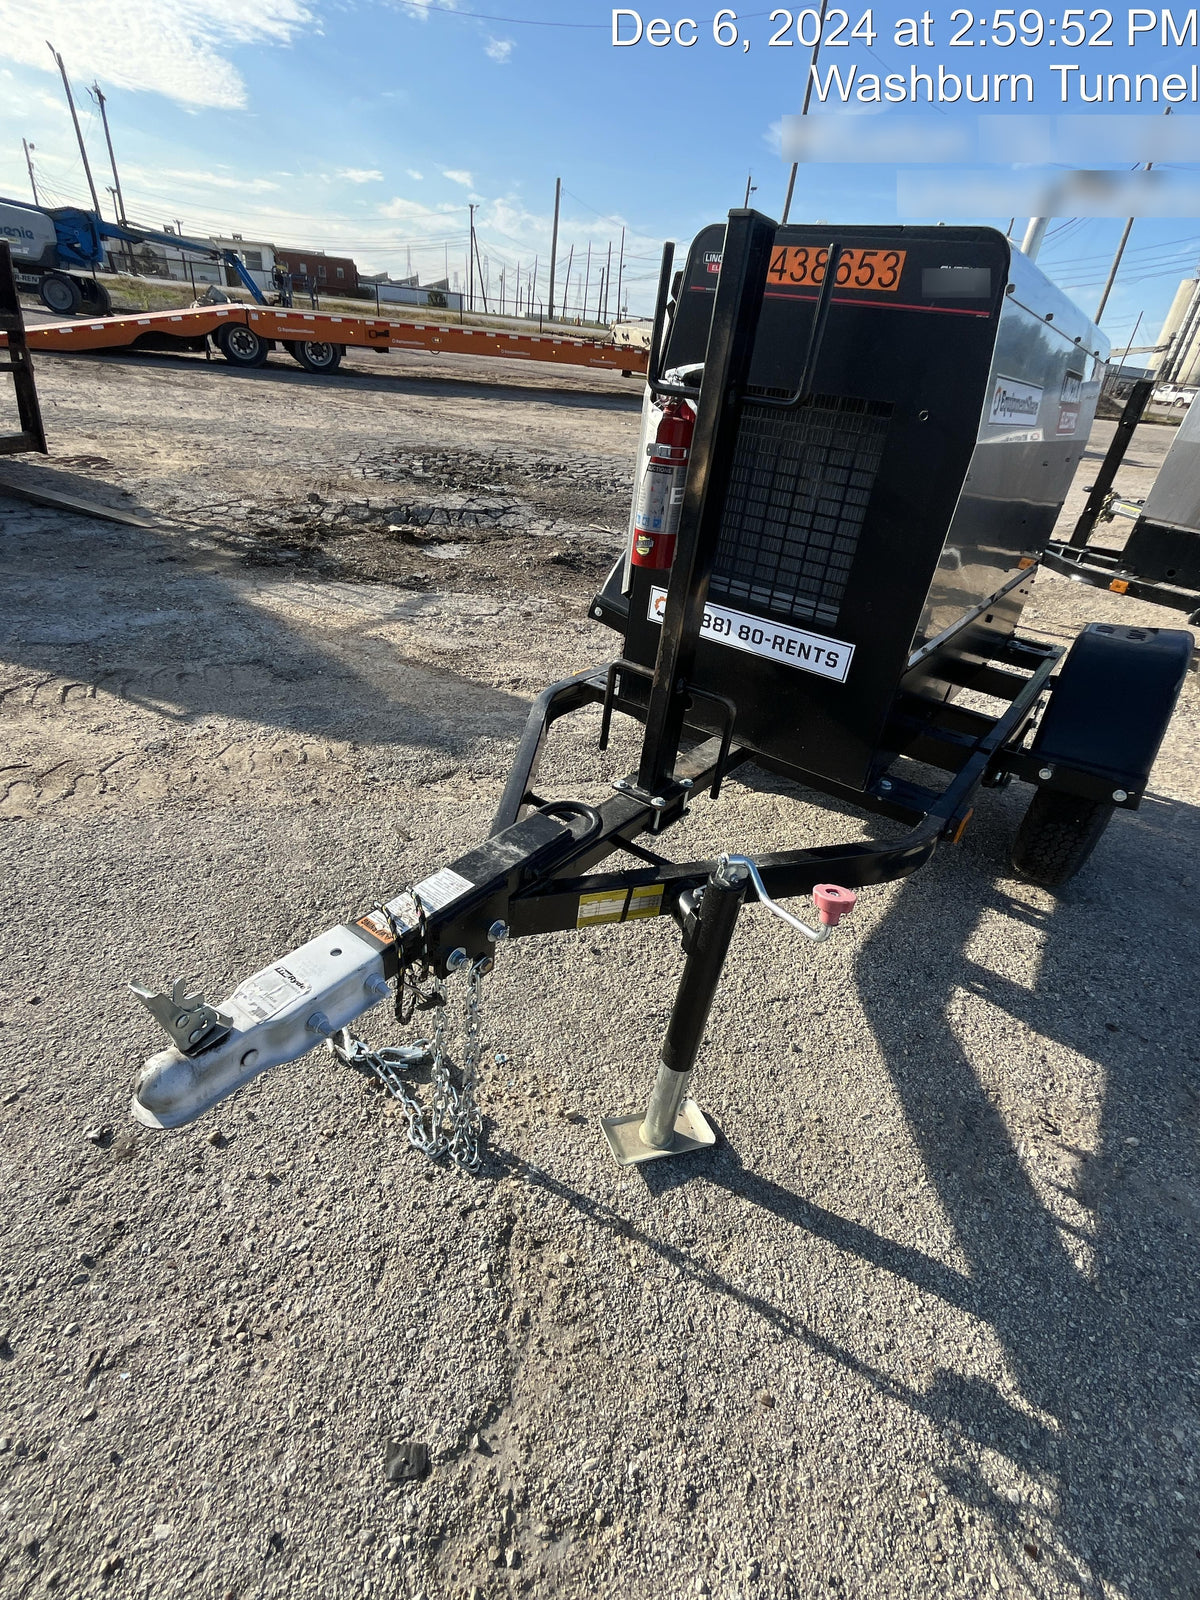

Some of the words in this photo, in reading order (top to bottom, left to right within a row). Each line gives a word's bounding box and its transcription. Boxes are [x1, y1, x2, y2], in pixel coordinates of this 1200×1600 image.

[0, 225, 35, 240] enie
[769, 247, 900, 289] 438653
[737, 624, 840, 669] 80-RENTS
